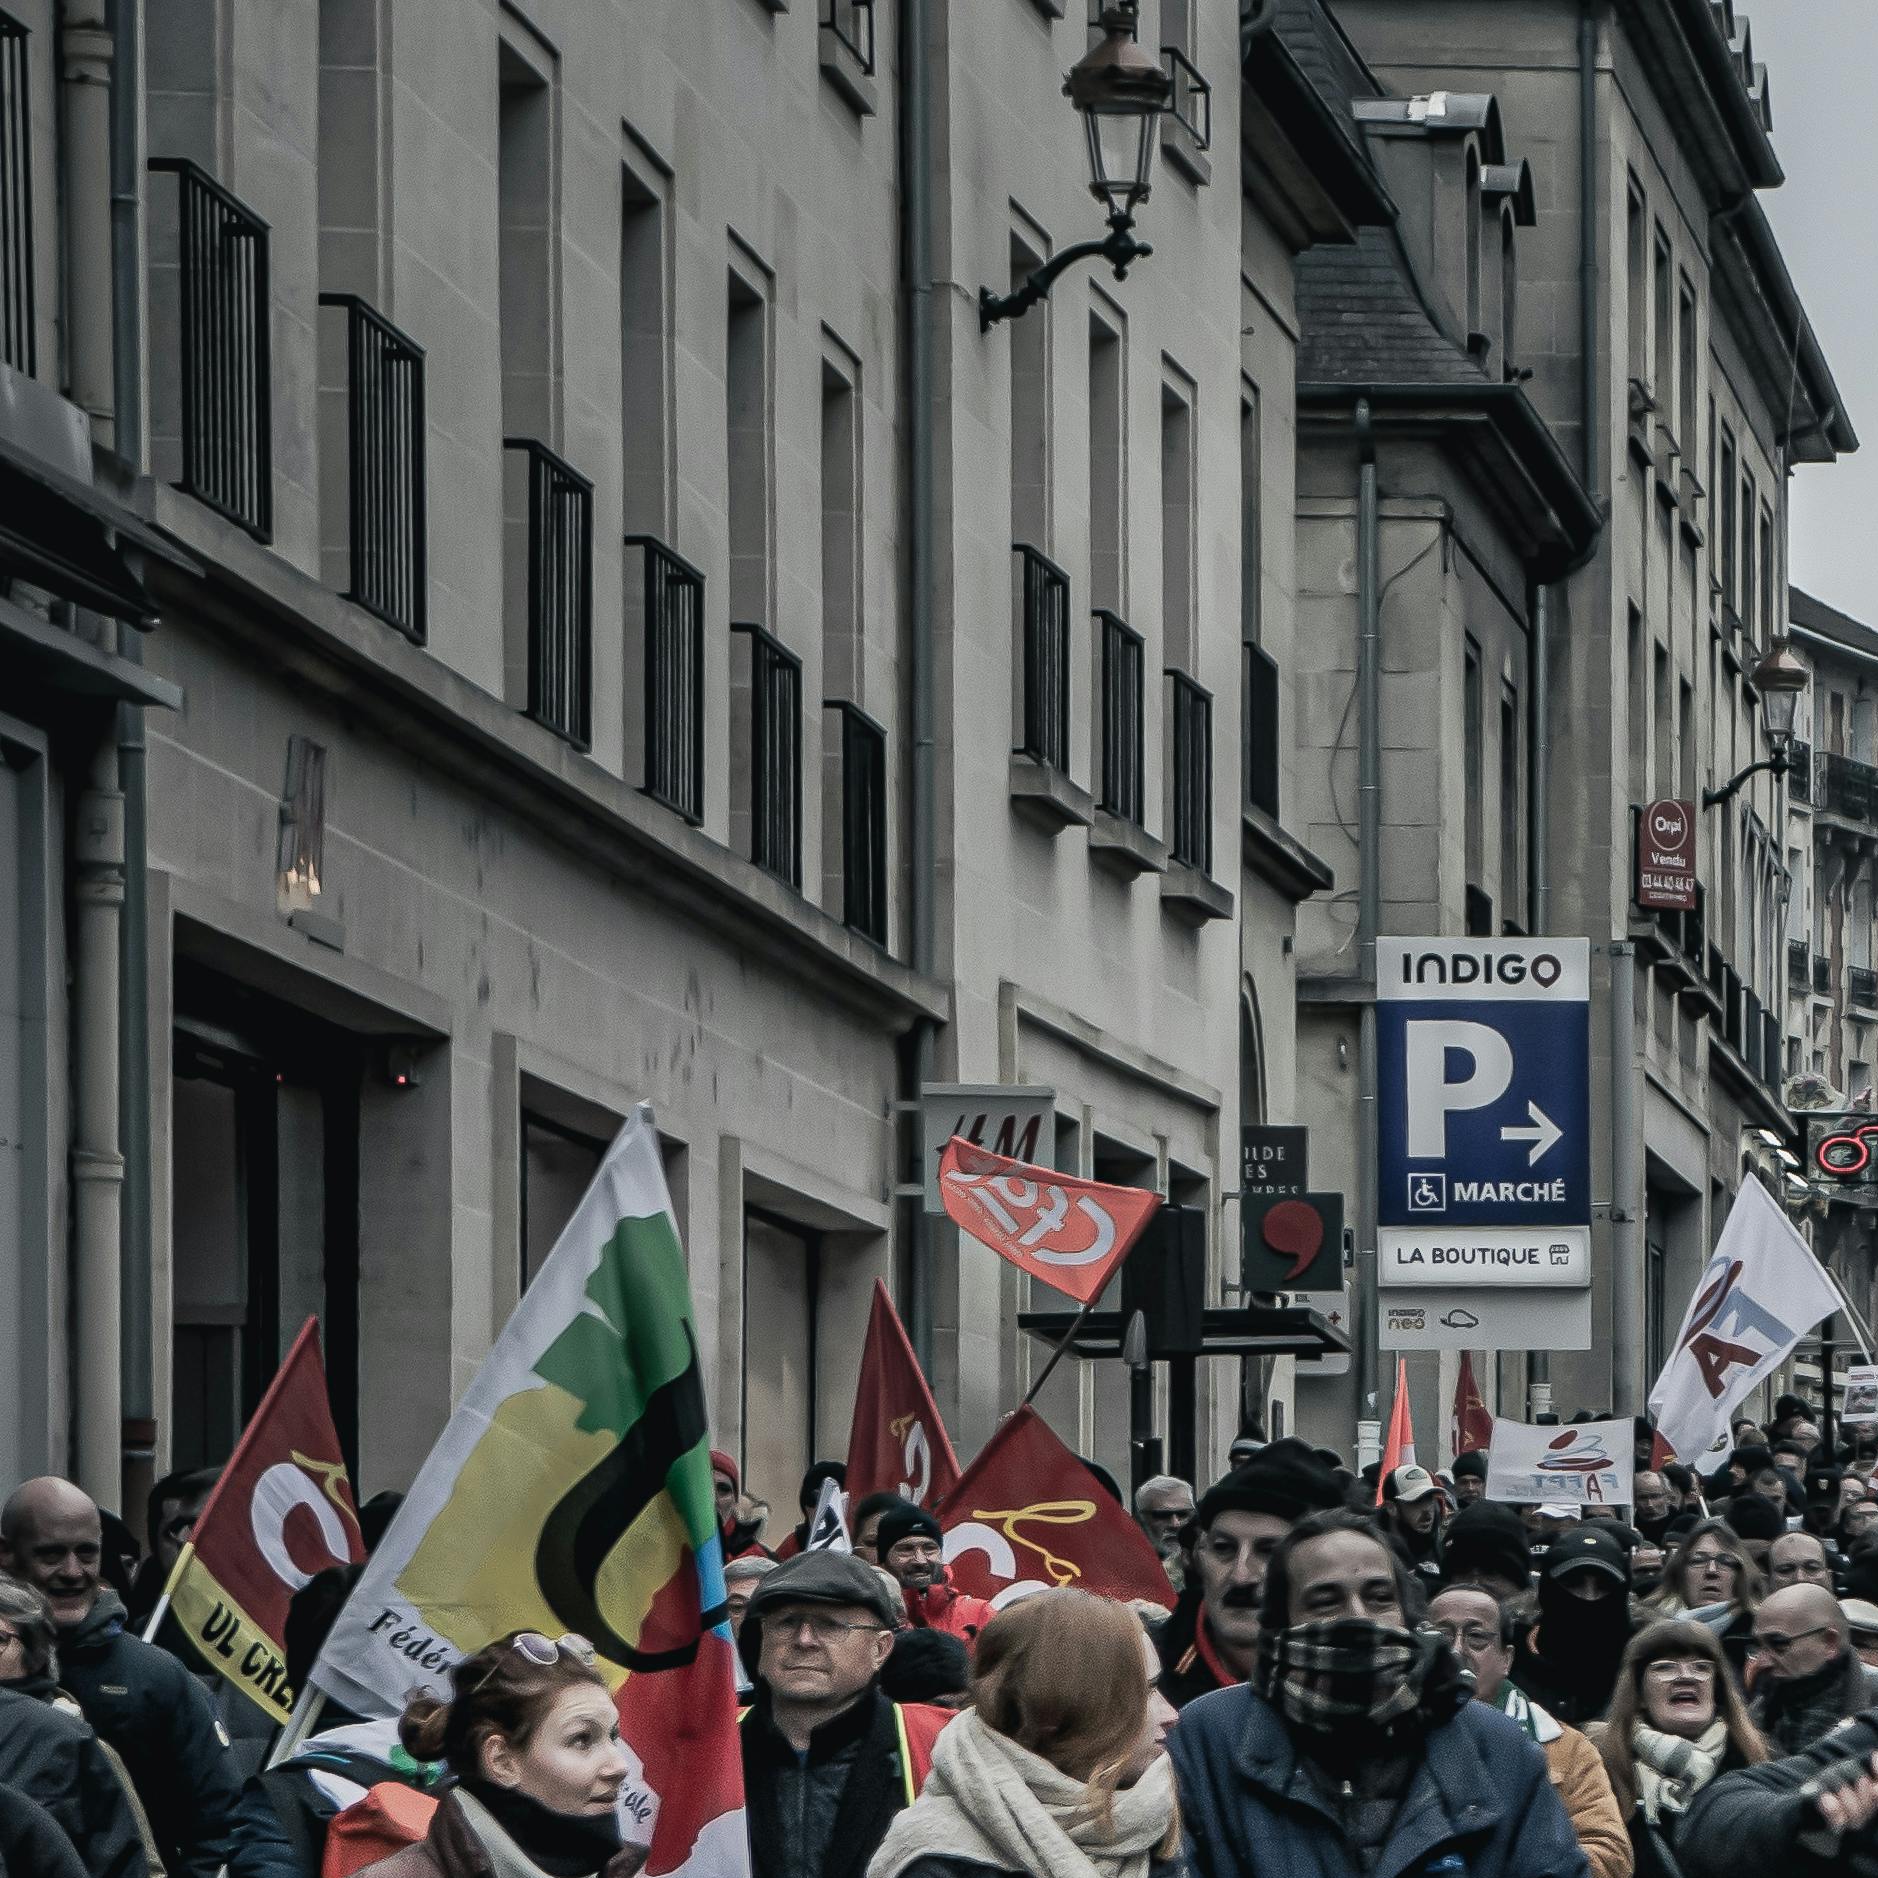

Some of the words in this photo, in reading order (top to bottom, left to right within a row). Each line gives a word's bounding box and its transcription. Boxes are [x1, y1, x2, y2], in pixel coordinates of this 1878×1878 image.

[1655, 816, 1682, 835] Orpi
[1651, 851, 1686, 868] Vendu
[1402, 952, 1563, 989] INDIGO
[1406, 1019, 1514, 1158] P
[1453, 1177, 1566, 1202] MARCHÉ
[1397, 1246, 1425, 1267] LA
[1431, 1246, 1540, 1268] BOUTIQUE
[201, 1600, 241, 1660] UL
[367, 1608, 453, 1677] Fédér
